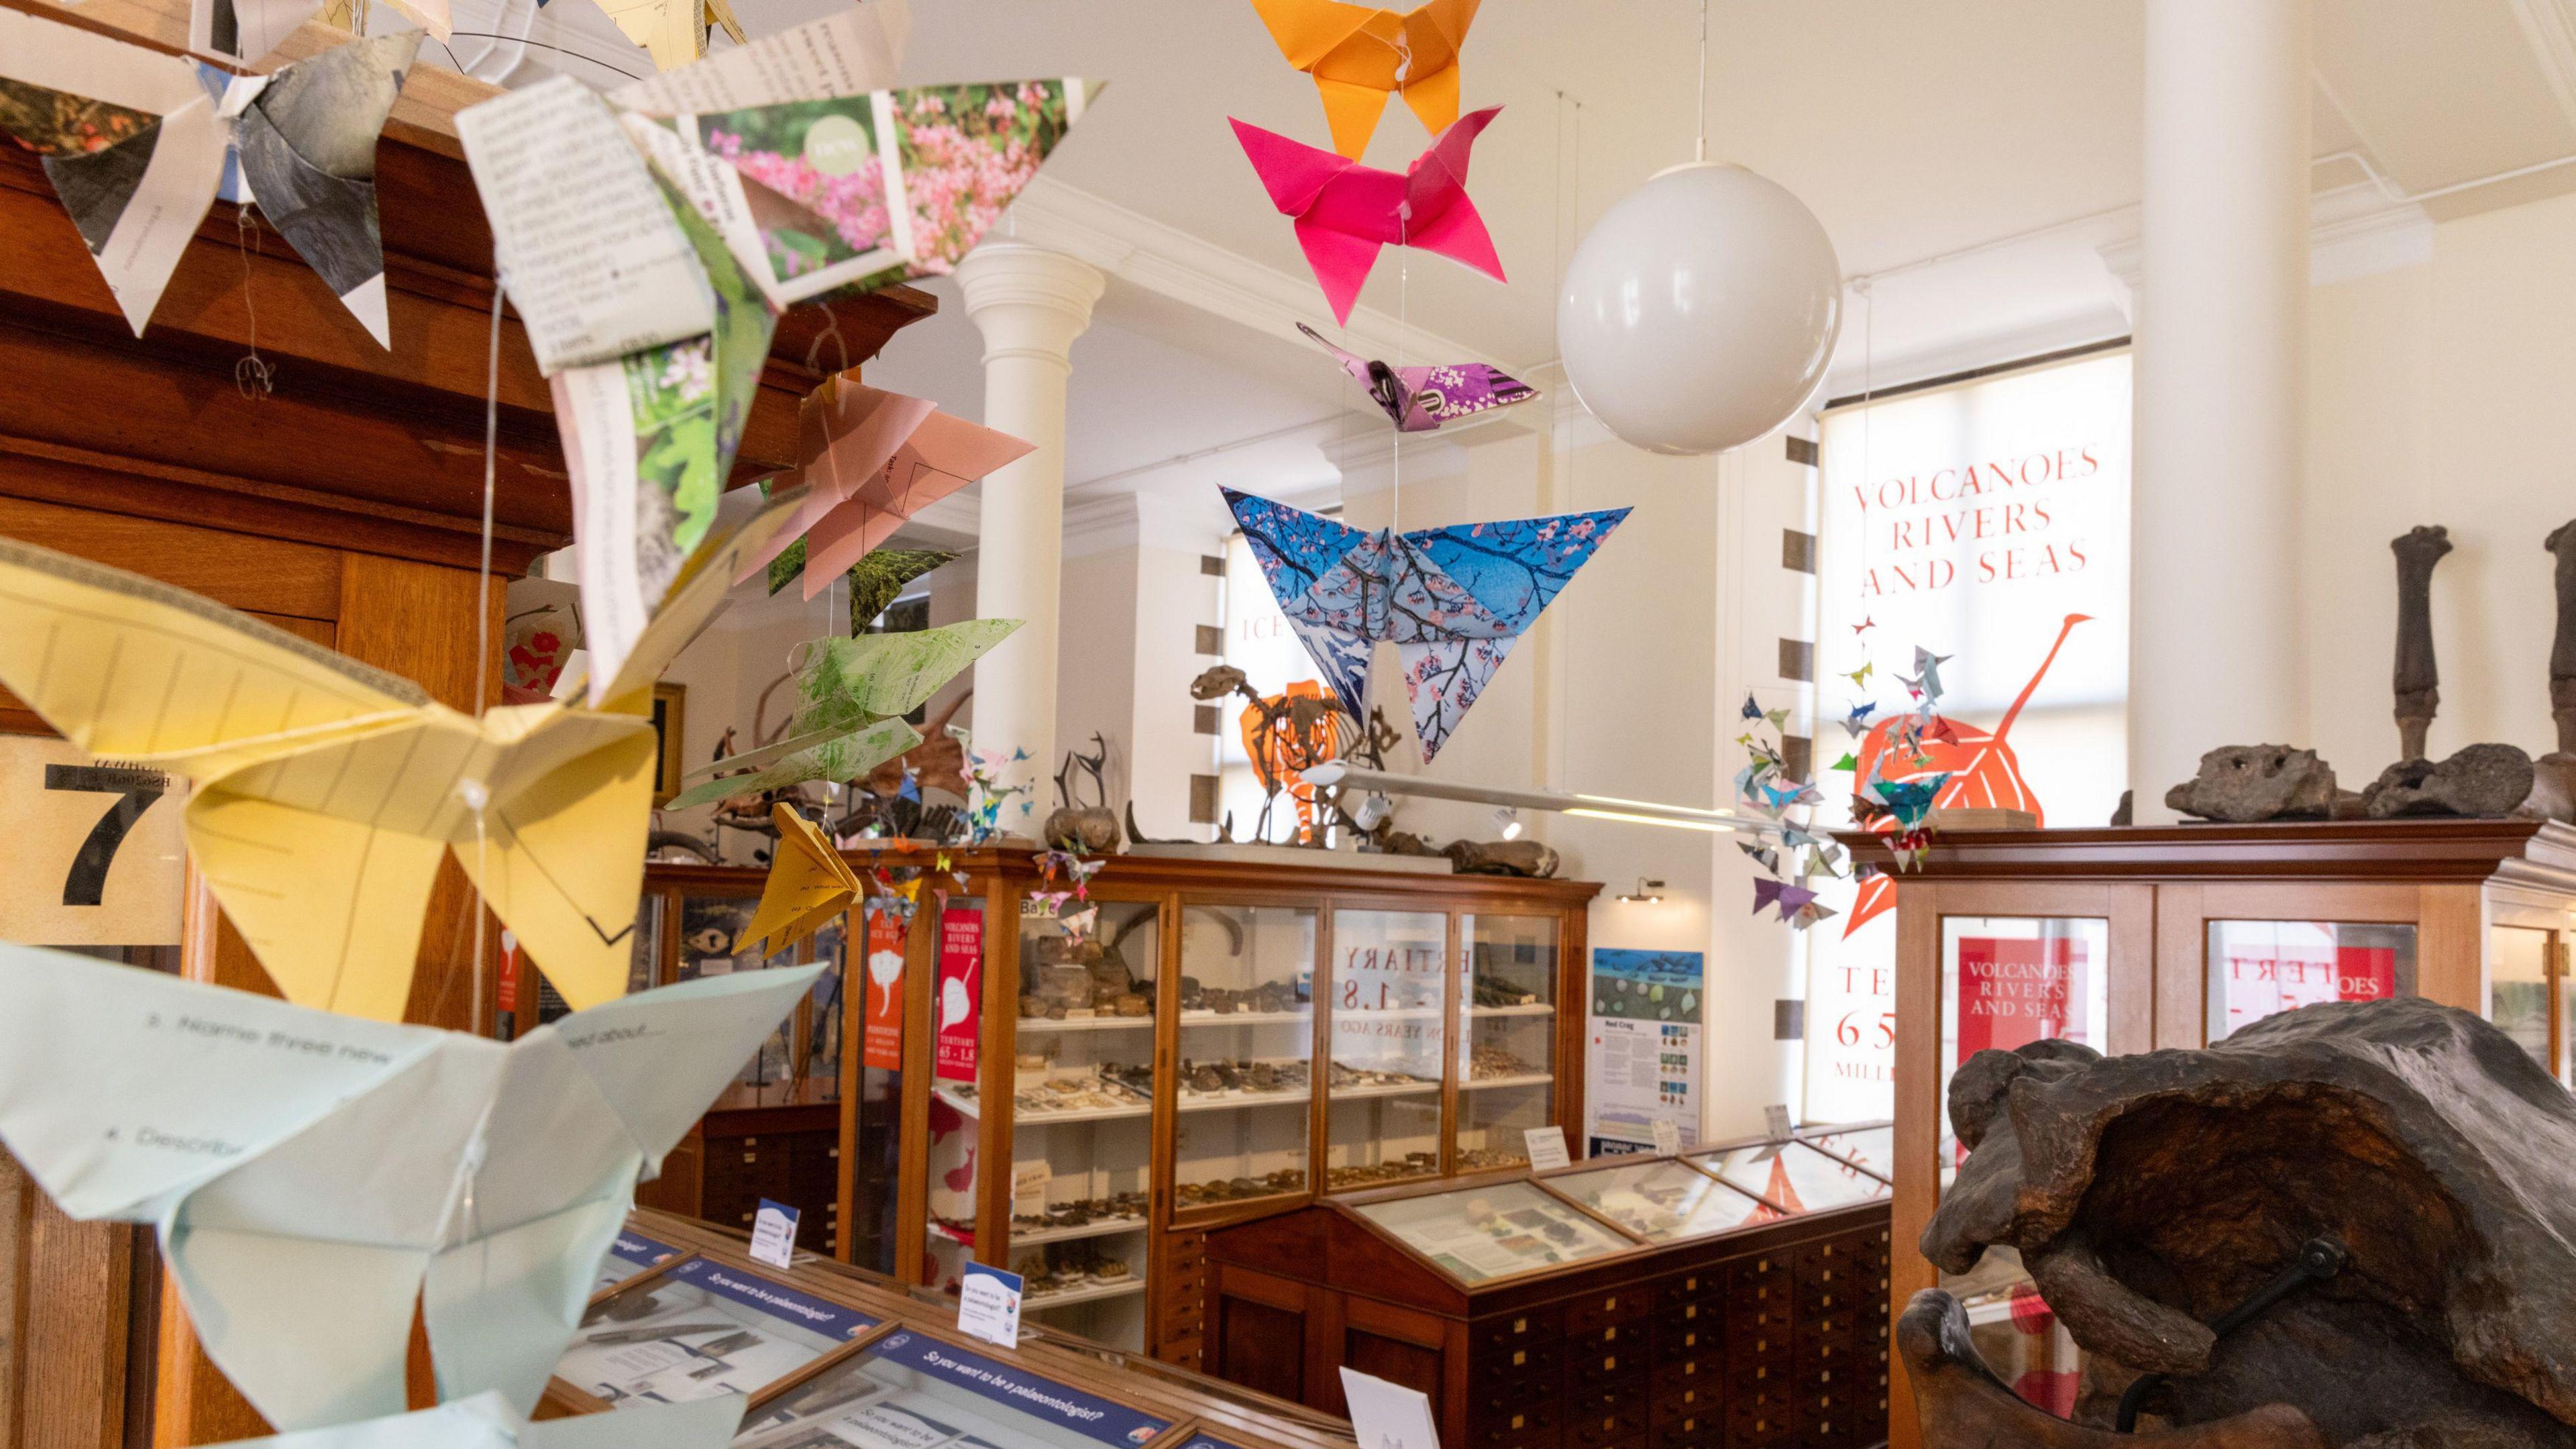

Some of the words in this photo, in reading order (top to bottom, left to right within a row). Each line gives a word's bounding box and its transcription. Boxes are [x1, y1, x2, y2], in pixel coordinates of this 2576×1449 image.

[1855, 442, 2099, 513] VOLCANOES
[1893, 498, 2051, 550] RIVERS
[1860, 558, 1955, 598] AND
[1978, 539, 2087, 584] SEAS
[1242, 616, 1284, 641] ICE
[45, 763, 165, 906] 7
[947, 932, 975, 944] RIVERS
[1968, 961, 2076, 981] VOLCANOES
[1980, 979, 2065, 1000] RIVERS
[1971, 1000, 2017, 1017] AND
[2025, 1002, 2073, 1020] SEAS
[1837, 1010, 1896, 1051] 65
[923, 1350, 939, 1362] So
[932, 1356, 958, 1369] you
[955, 1363, 983, 1378] want
[978, 1371, 992, 1382] to
[990, 1375, 1007, 1388] be
[1004, 1383, 1015, 1391] a
[1008, 1387, 1105, 1421] palaeontologist?
